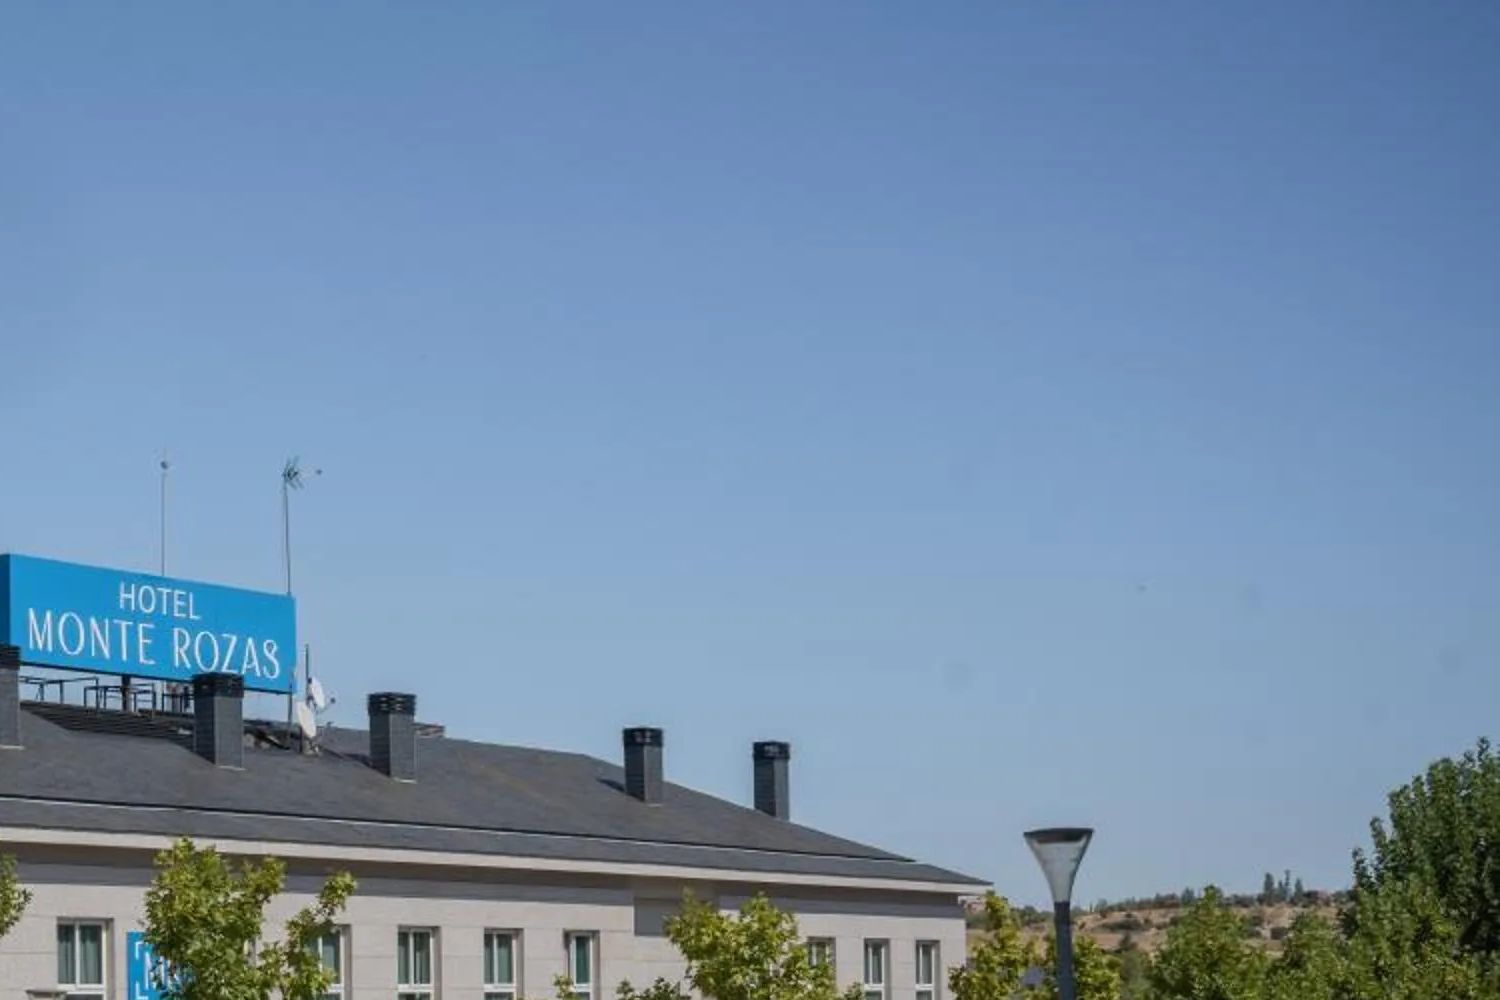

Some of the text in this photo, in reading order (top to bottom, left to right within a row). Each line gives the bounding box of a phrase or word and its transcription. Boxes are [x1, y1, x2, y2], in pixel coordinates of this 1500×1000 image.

[119, 582, 201, 621] HOTEL
[28, 608, 280, 679] MONTE ROZAS
